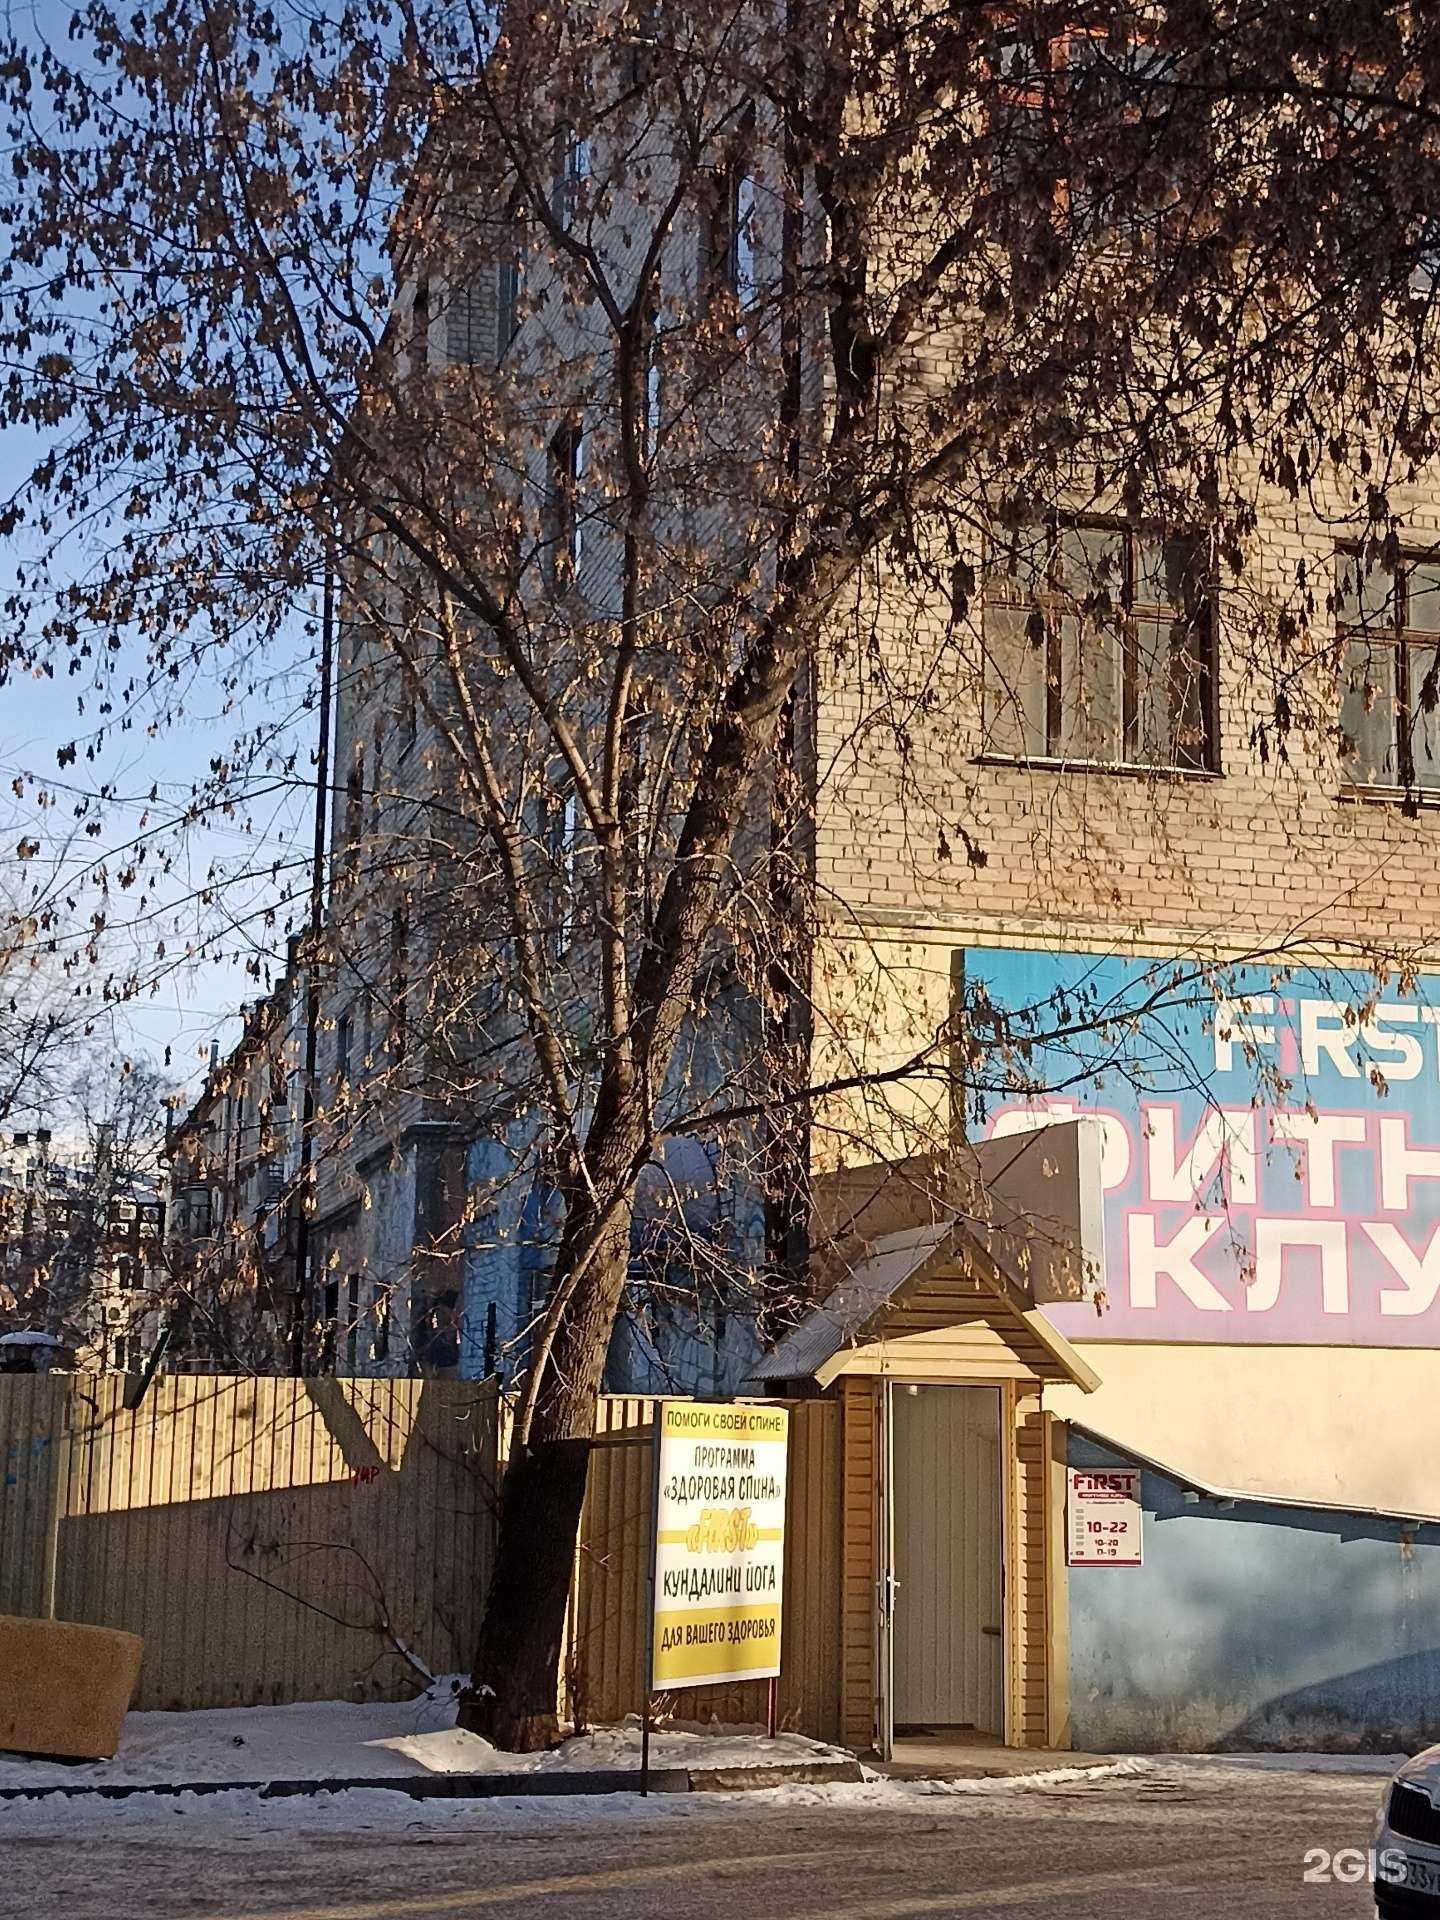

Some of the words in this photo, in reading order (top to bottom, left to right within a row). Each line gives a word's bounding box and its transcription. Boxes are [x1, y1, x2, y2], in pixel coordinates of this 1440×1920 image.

[667, 1411, 710, 1428] ПОМОГИ
[713, 1412, 747, 1430] СВОЕЙ
[749, 1416, 783, 1431] СПИНЕ!
[695, 1446, 755, 1469] ПРОГРАММА
[664, 1475, 735, 1505] «ЗДОРОВАЯ
[1086, 1521, 1128, 1533] 10-22
[664, 1566, 741, 1602] КУНДАЛИНИ
[746, 1561, 776, 1592] ЙОГА
[661, 1626, 682, 1651] ДЛЯ
[686, 1622, 726, 1645] ВАШЕГО
[727, 1618, 776, 1644] ЗДОРОВЬЯ
